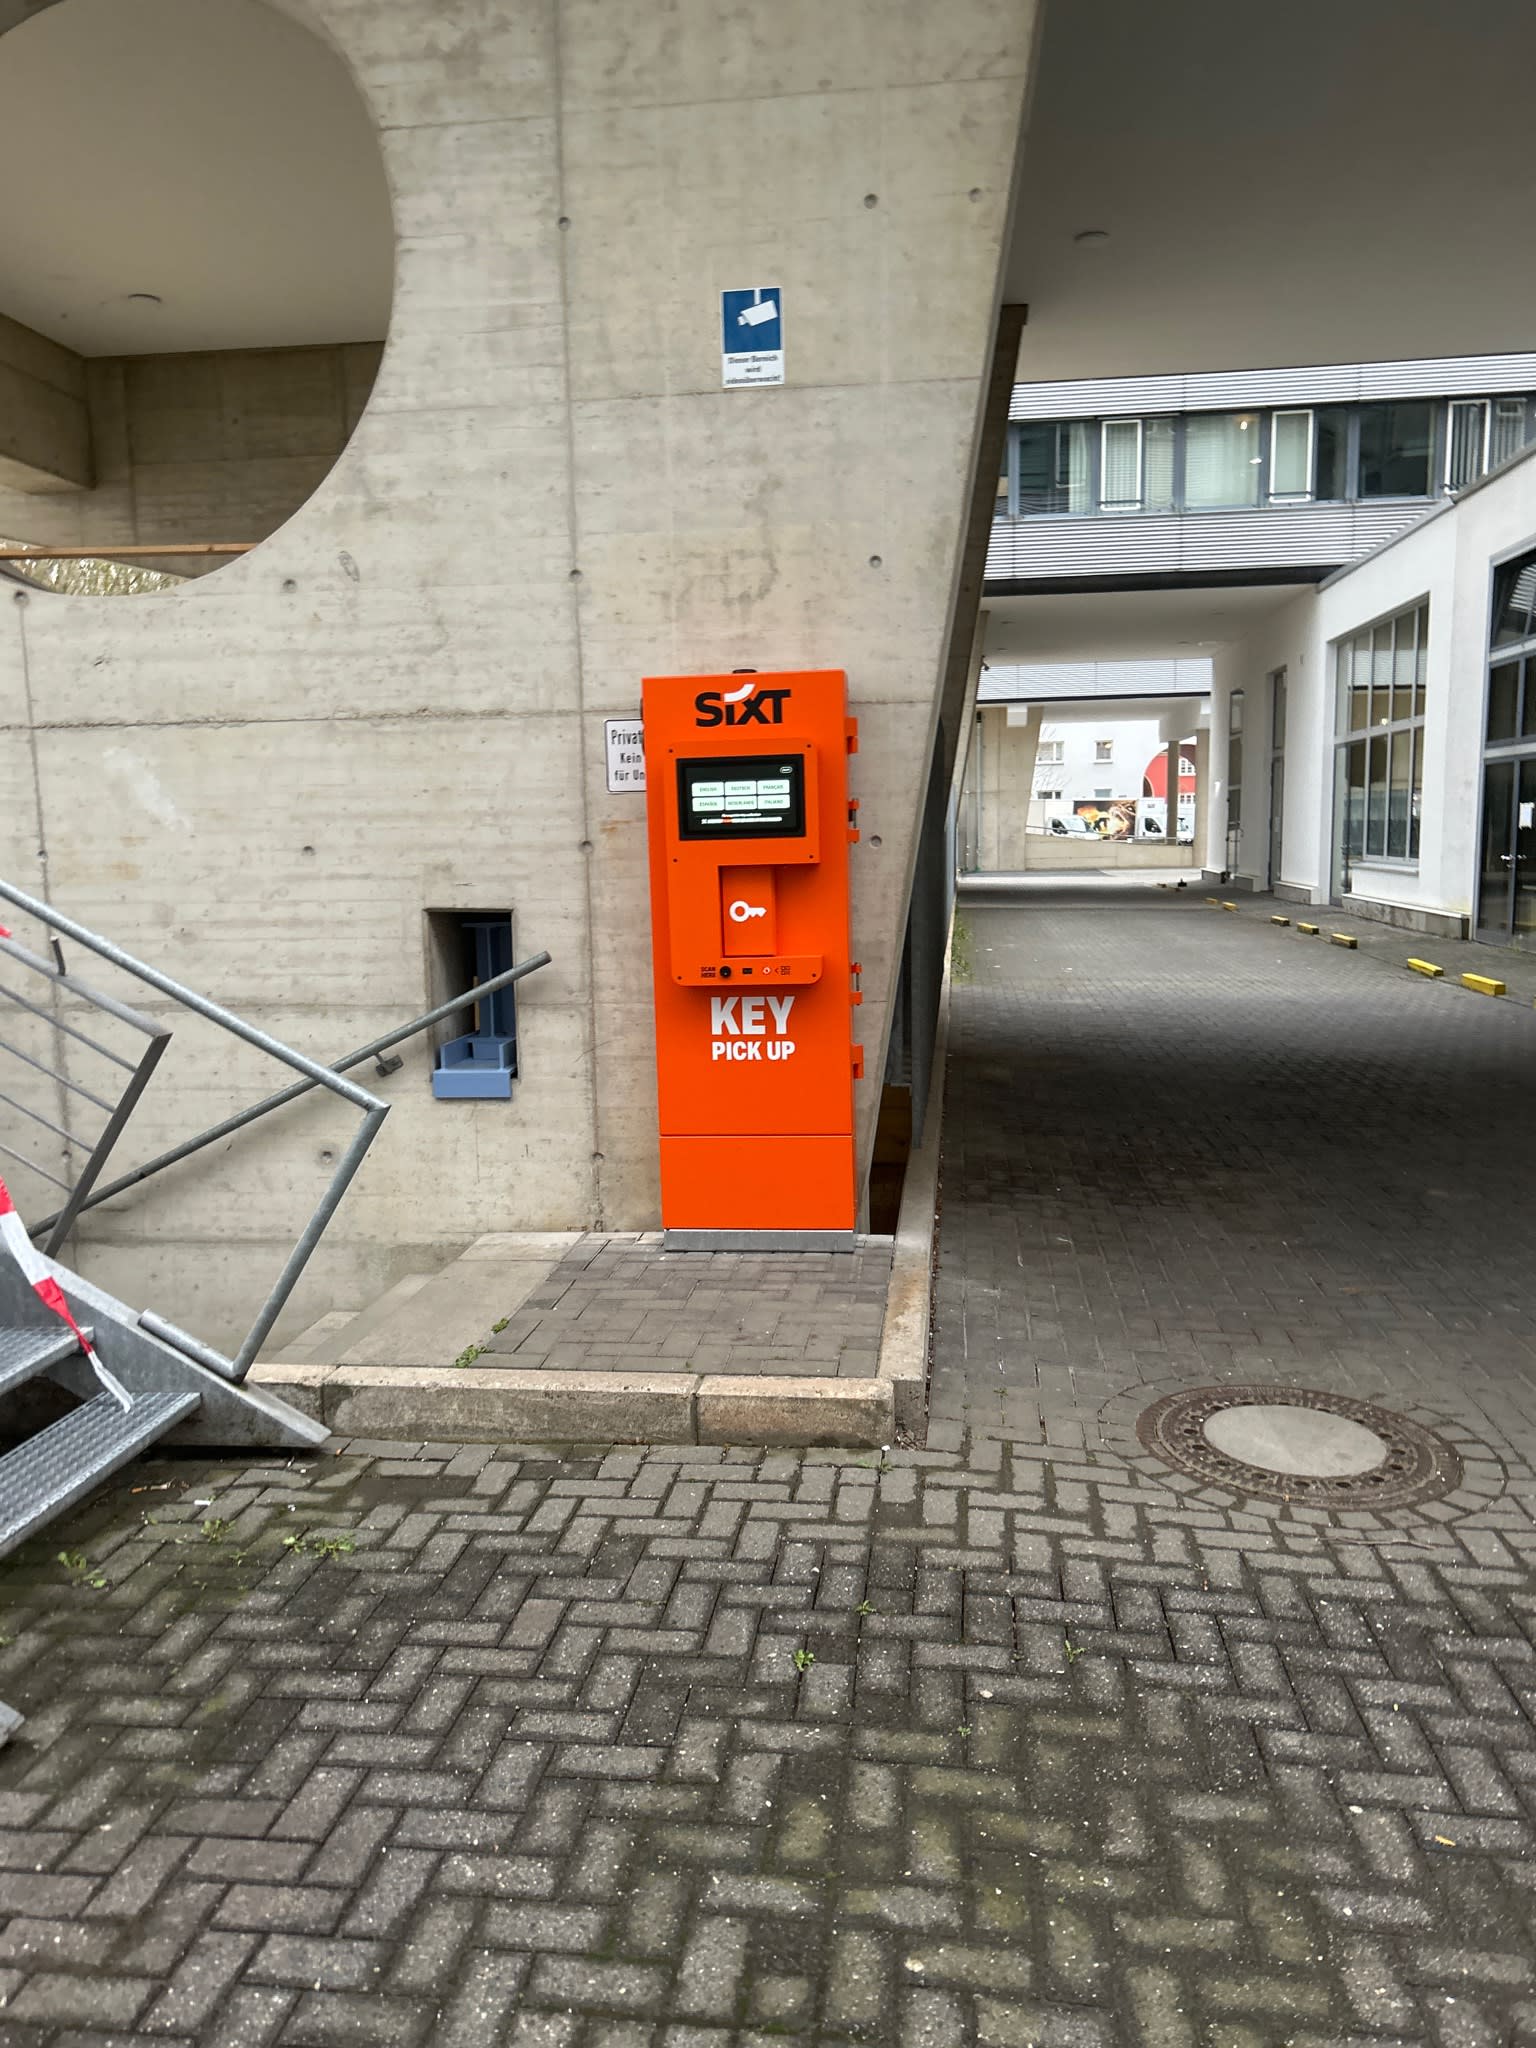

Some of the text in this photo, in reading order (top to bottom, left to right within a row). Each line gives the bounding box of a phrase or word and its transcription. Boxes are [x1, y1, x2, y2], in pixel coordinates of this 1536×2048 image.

[695, 684, 791, 727] SIXT
[620, 752, 642, 763] Kein
[615, 769, 629, 781] für
[711, 996, 795, 1035] KEY
[712, 1041, 796, 1061] PICK UP
